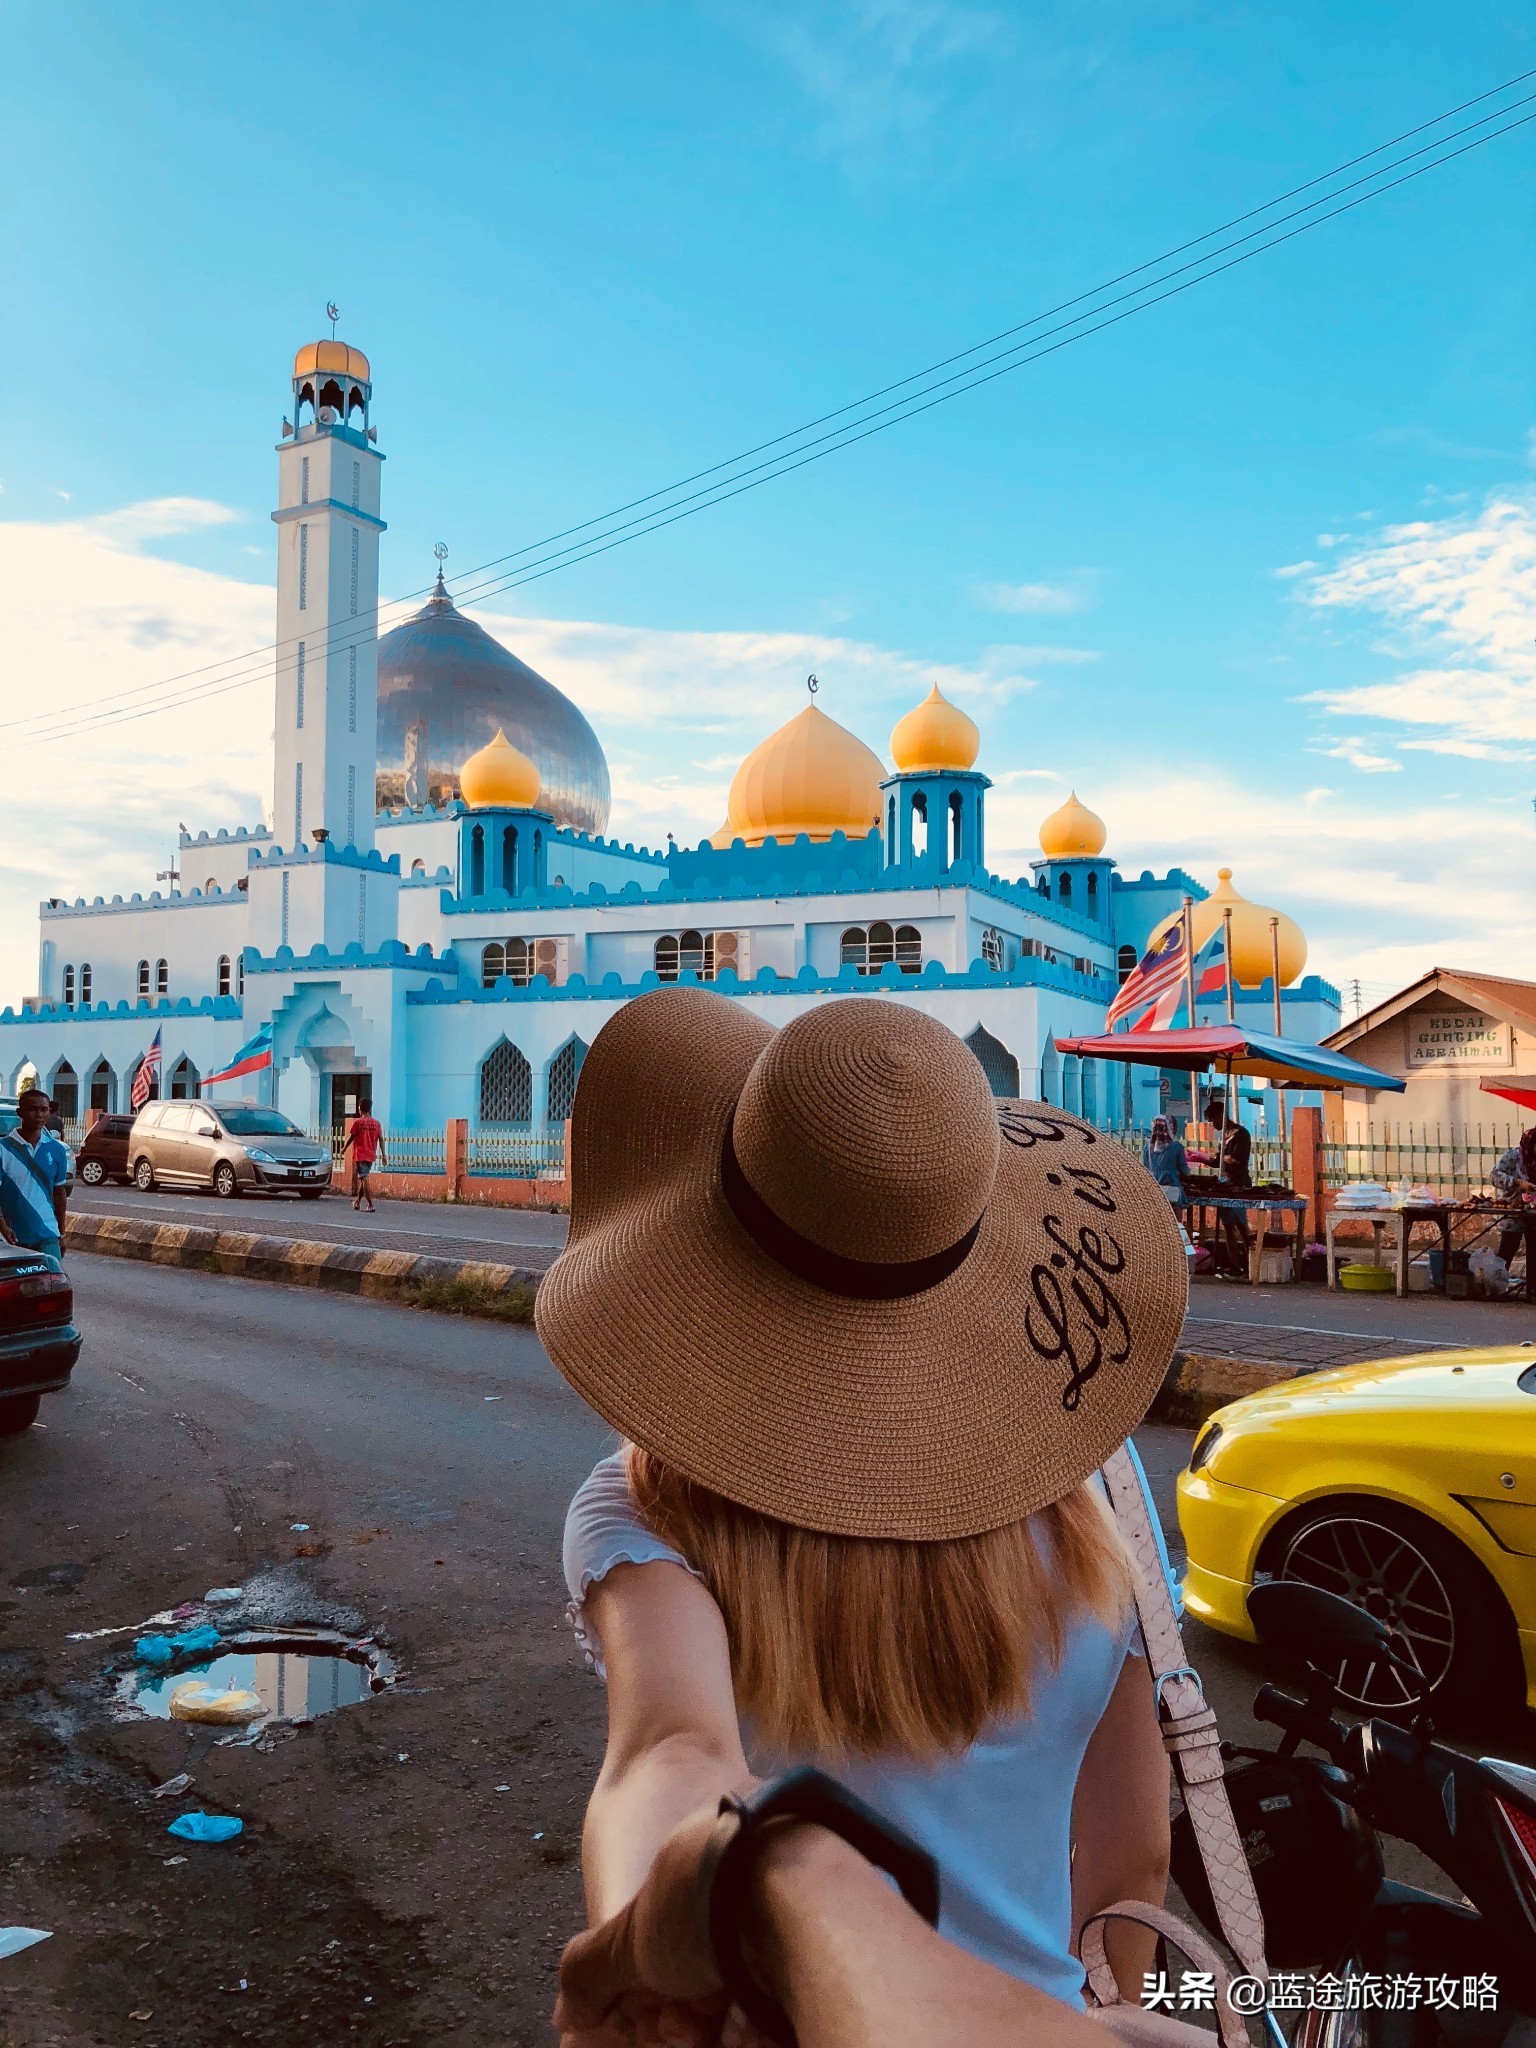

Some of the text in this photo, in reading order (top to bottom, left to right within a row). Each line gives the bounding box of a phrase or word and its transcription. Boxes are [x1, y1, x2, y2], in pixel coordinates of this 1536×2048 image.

[1414, 1046, 1503, 1058] ARRAHMAN
[1046, 1164, 1117, 1213] is
[16, 1264, 48, 1274] WIRA
[1024, 1214, 1131, 1412] Life
